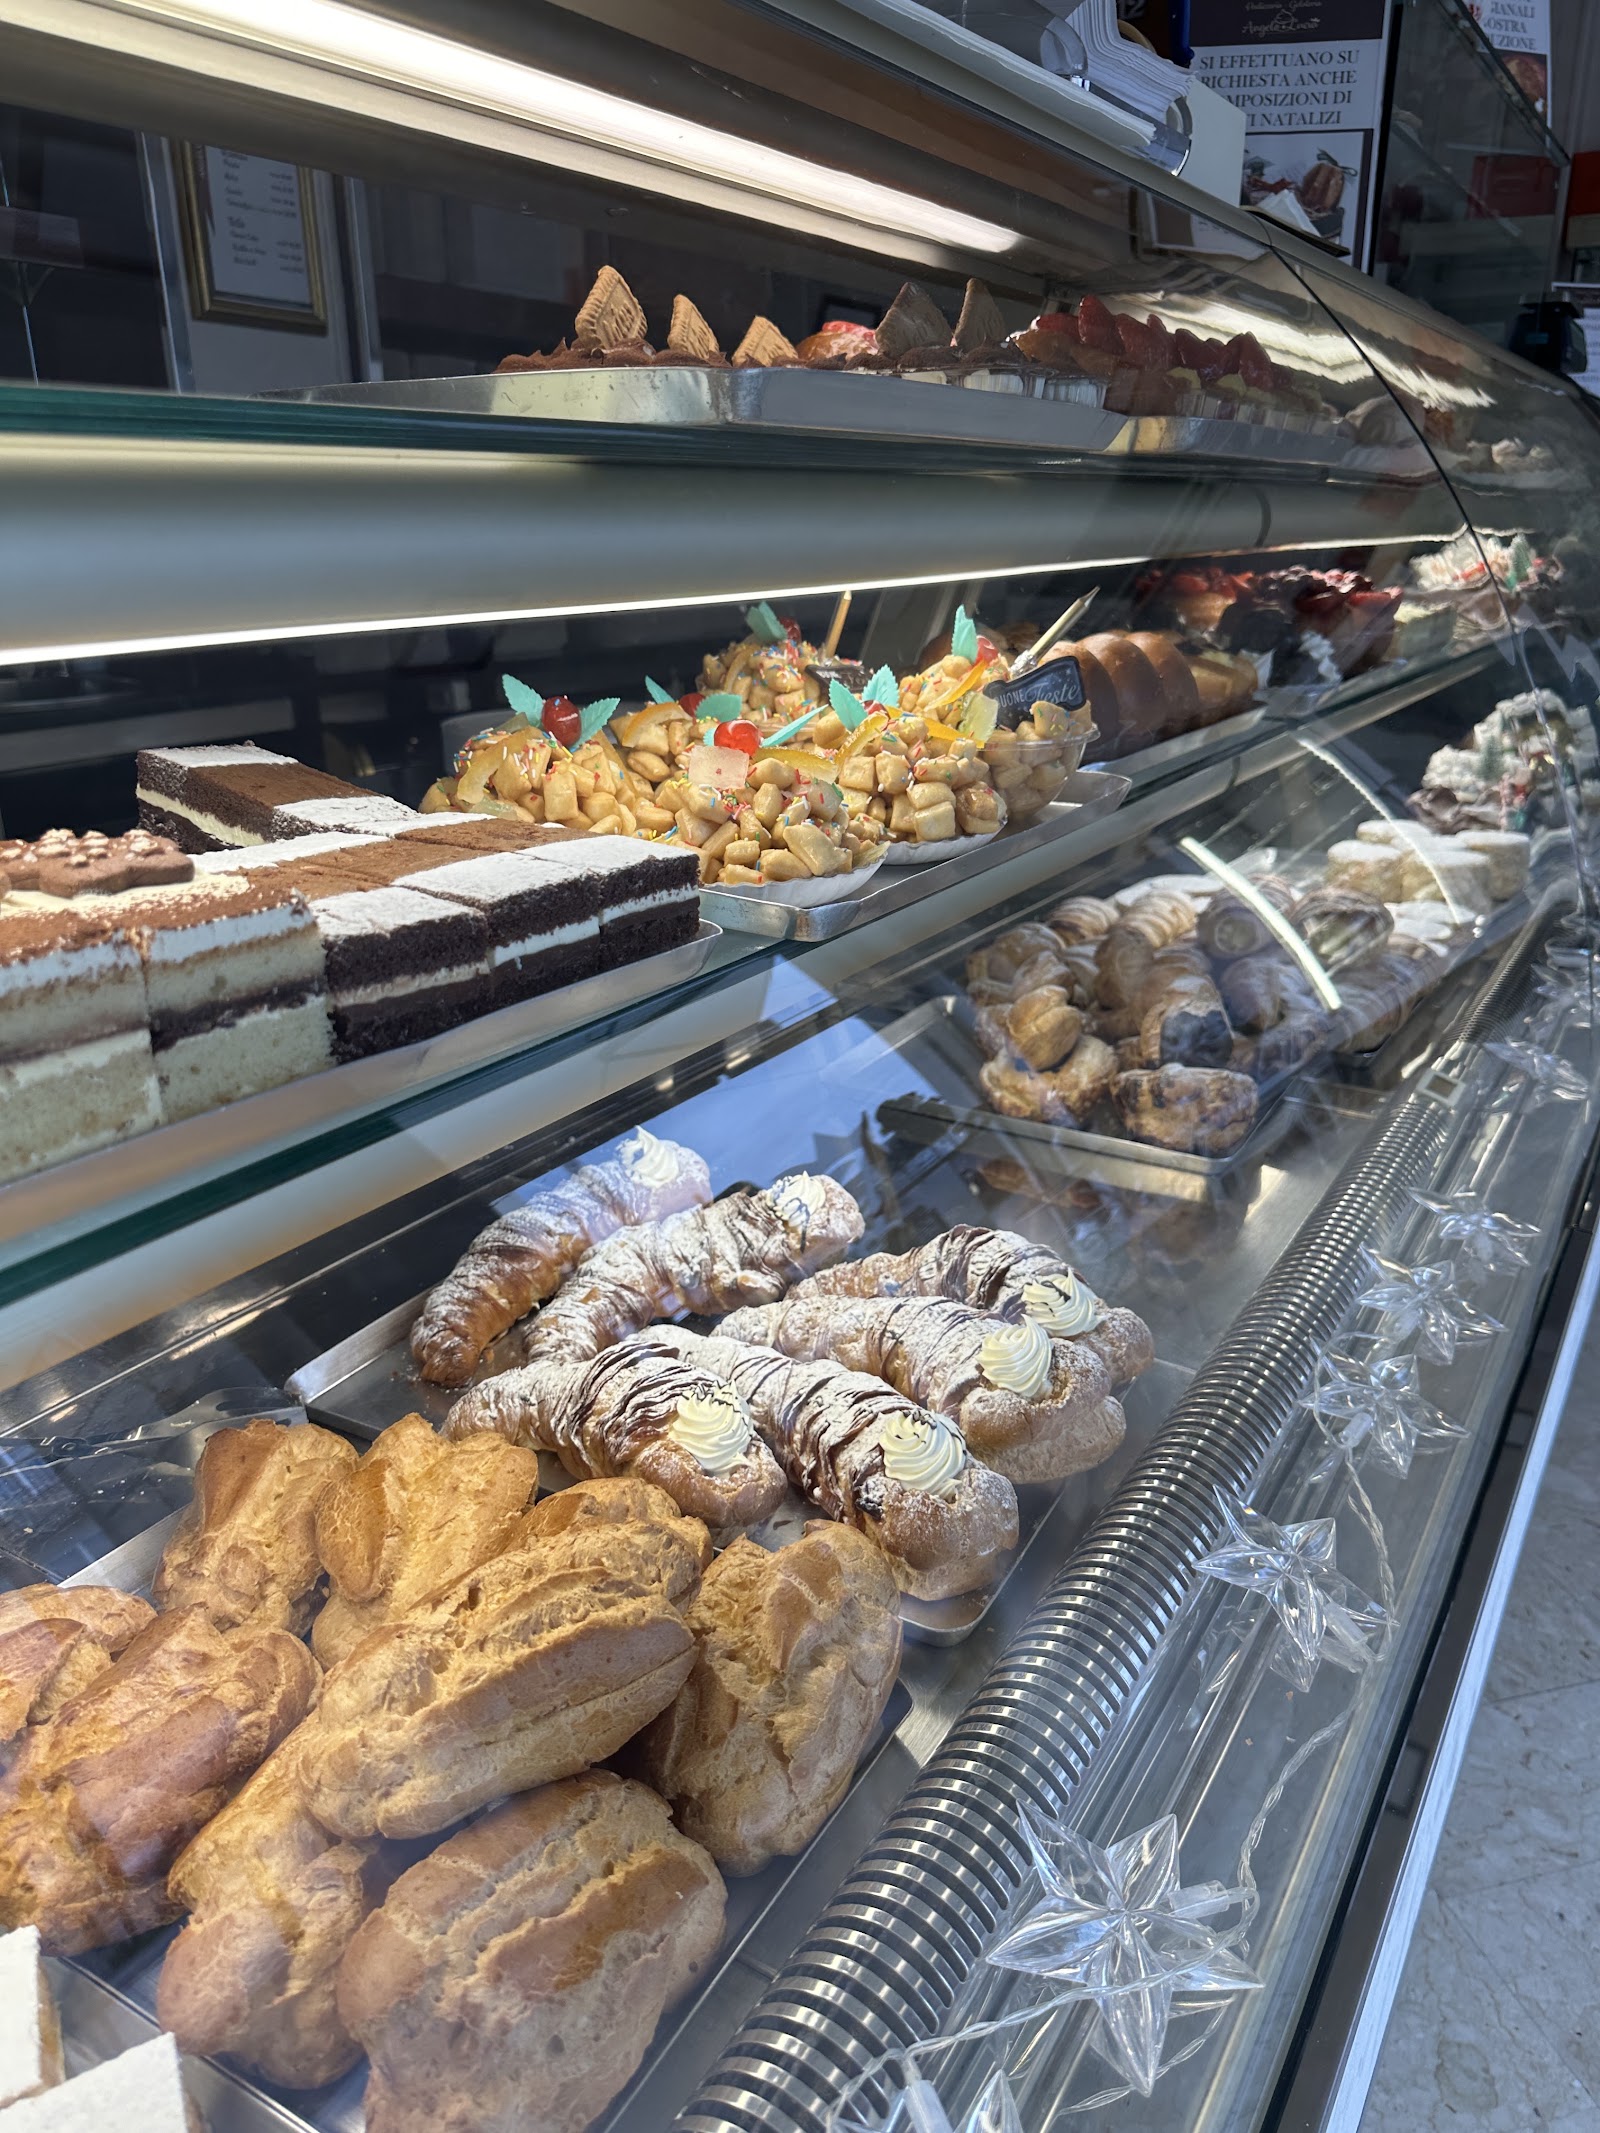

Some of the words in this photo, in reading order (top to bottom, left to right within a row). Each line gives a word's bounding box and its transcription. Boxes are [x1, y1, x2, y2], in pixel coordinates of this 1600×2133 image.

[1484, 16, 1527, 33] OSTRA
[1489, 33, 1537, 50] UZIONE
[1200, 56, 1214, 70] SI
[1219, 51, 1334, 69] EFFETTUANO
[1337, 50, 1360, 65] SU
[1201, 73, 1290, 89] RICHIESTA
[1295, 70, 1358, 87] ANCHE
[1224, 91, 1328, 108] MPOSIZIONI
[1333, 90, 1353, 105] DI
[1260, 110, 1343, 127] NATALIZI
